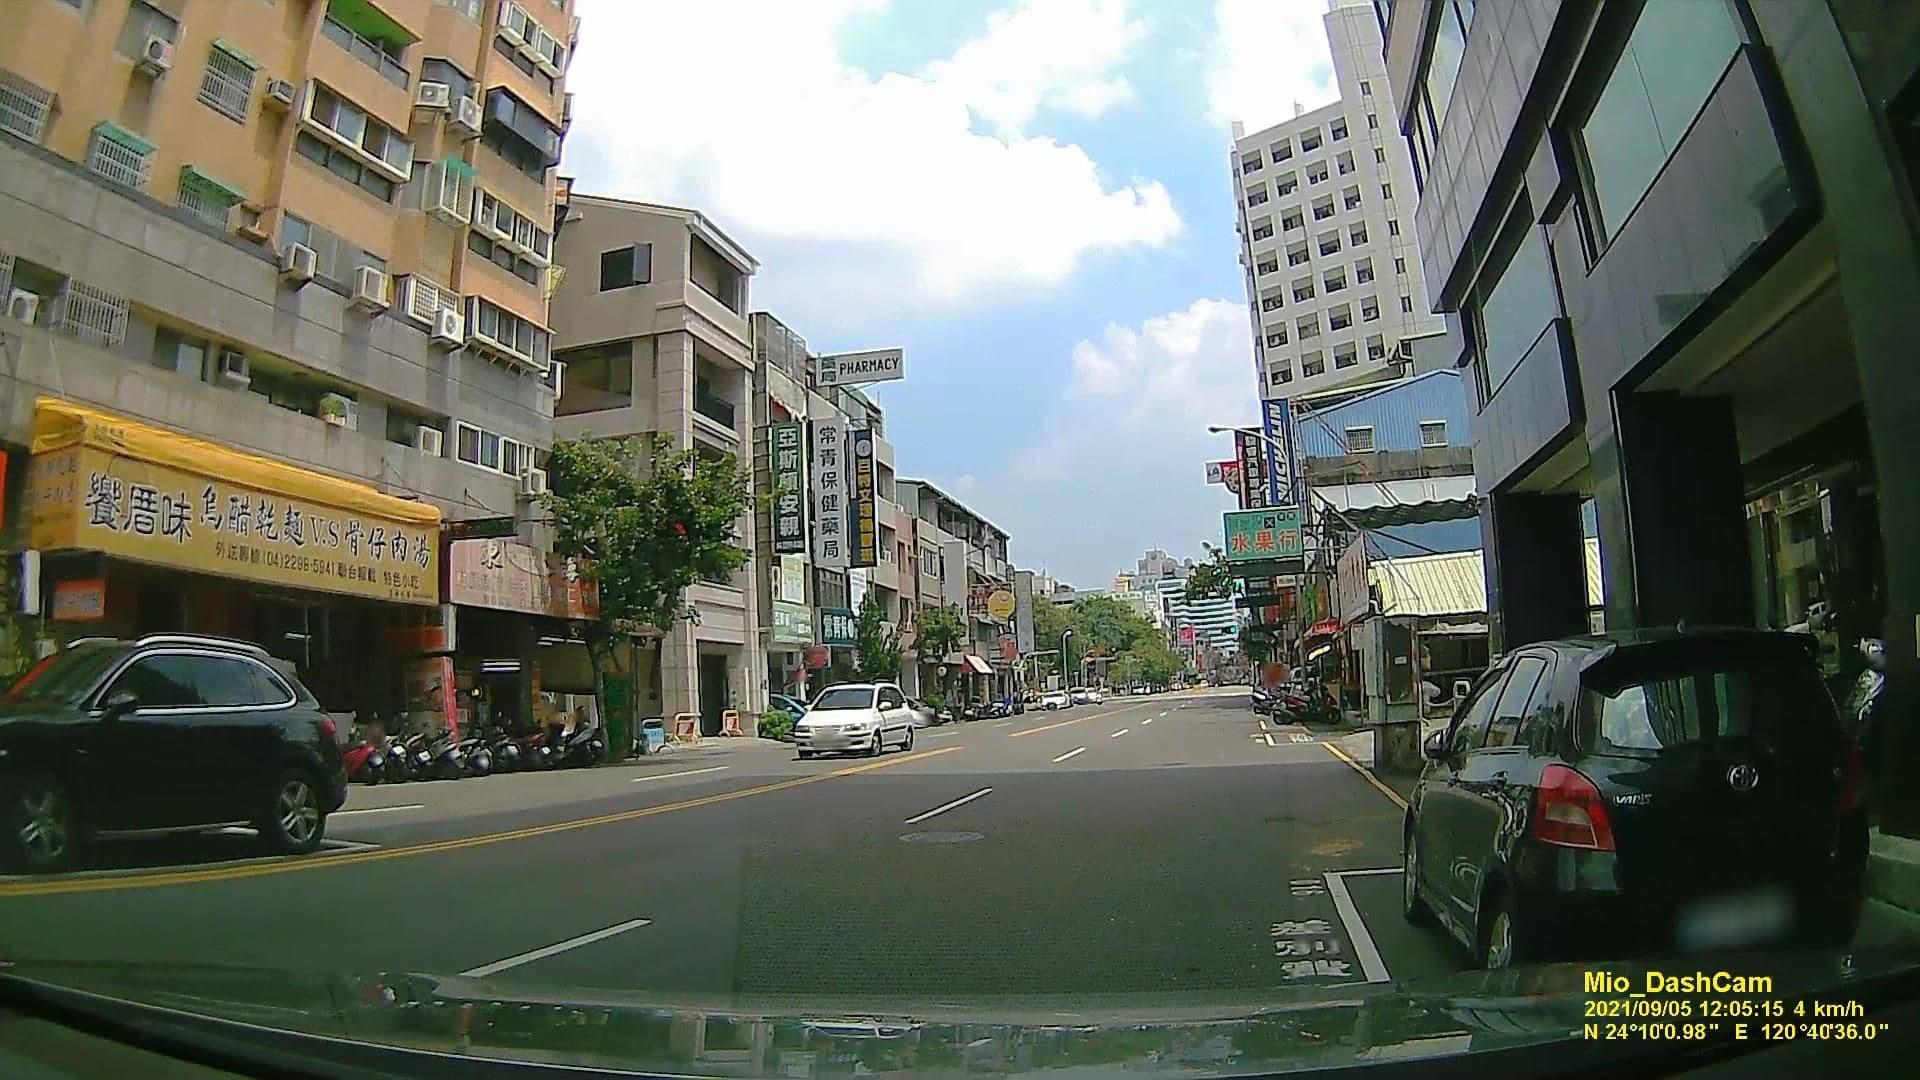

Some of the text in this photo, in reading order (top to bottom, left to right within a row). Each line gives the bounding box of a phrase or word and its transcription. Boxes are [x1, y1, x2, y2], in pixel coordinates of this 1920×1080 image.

[839, 357, 900, 376] PHARMACY
[1268, 403, 1289, 503] MICHELIN
[819, 425, 840, 559] 常青保健藥局
[1230, 528, 1298, 554] 水果行
